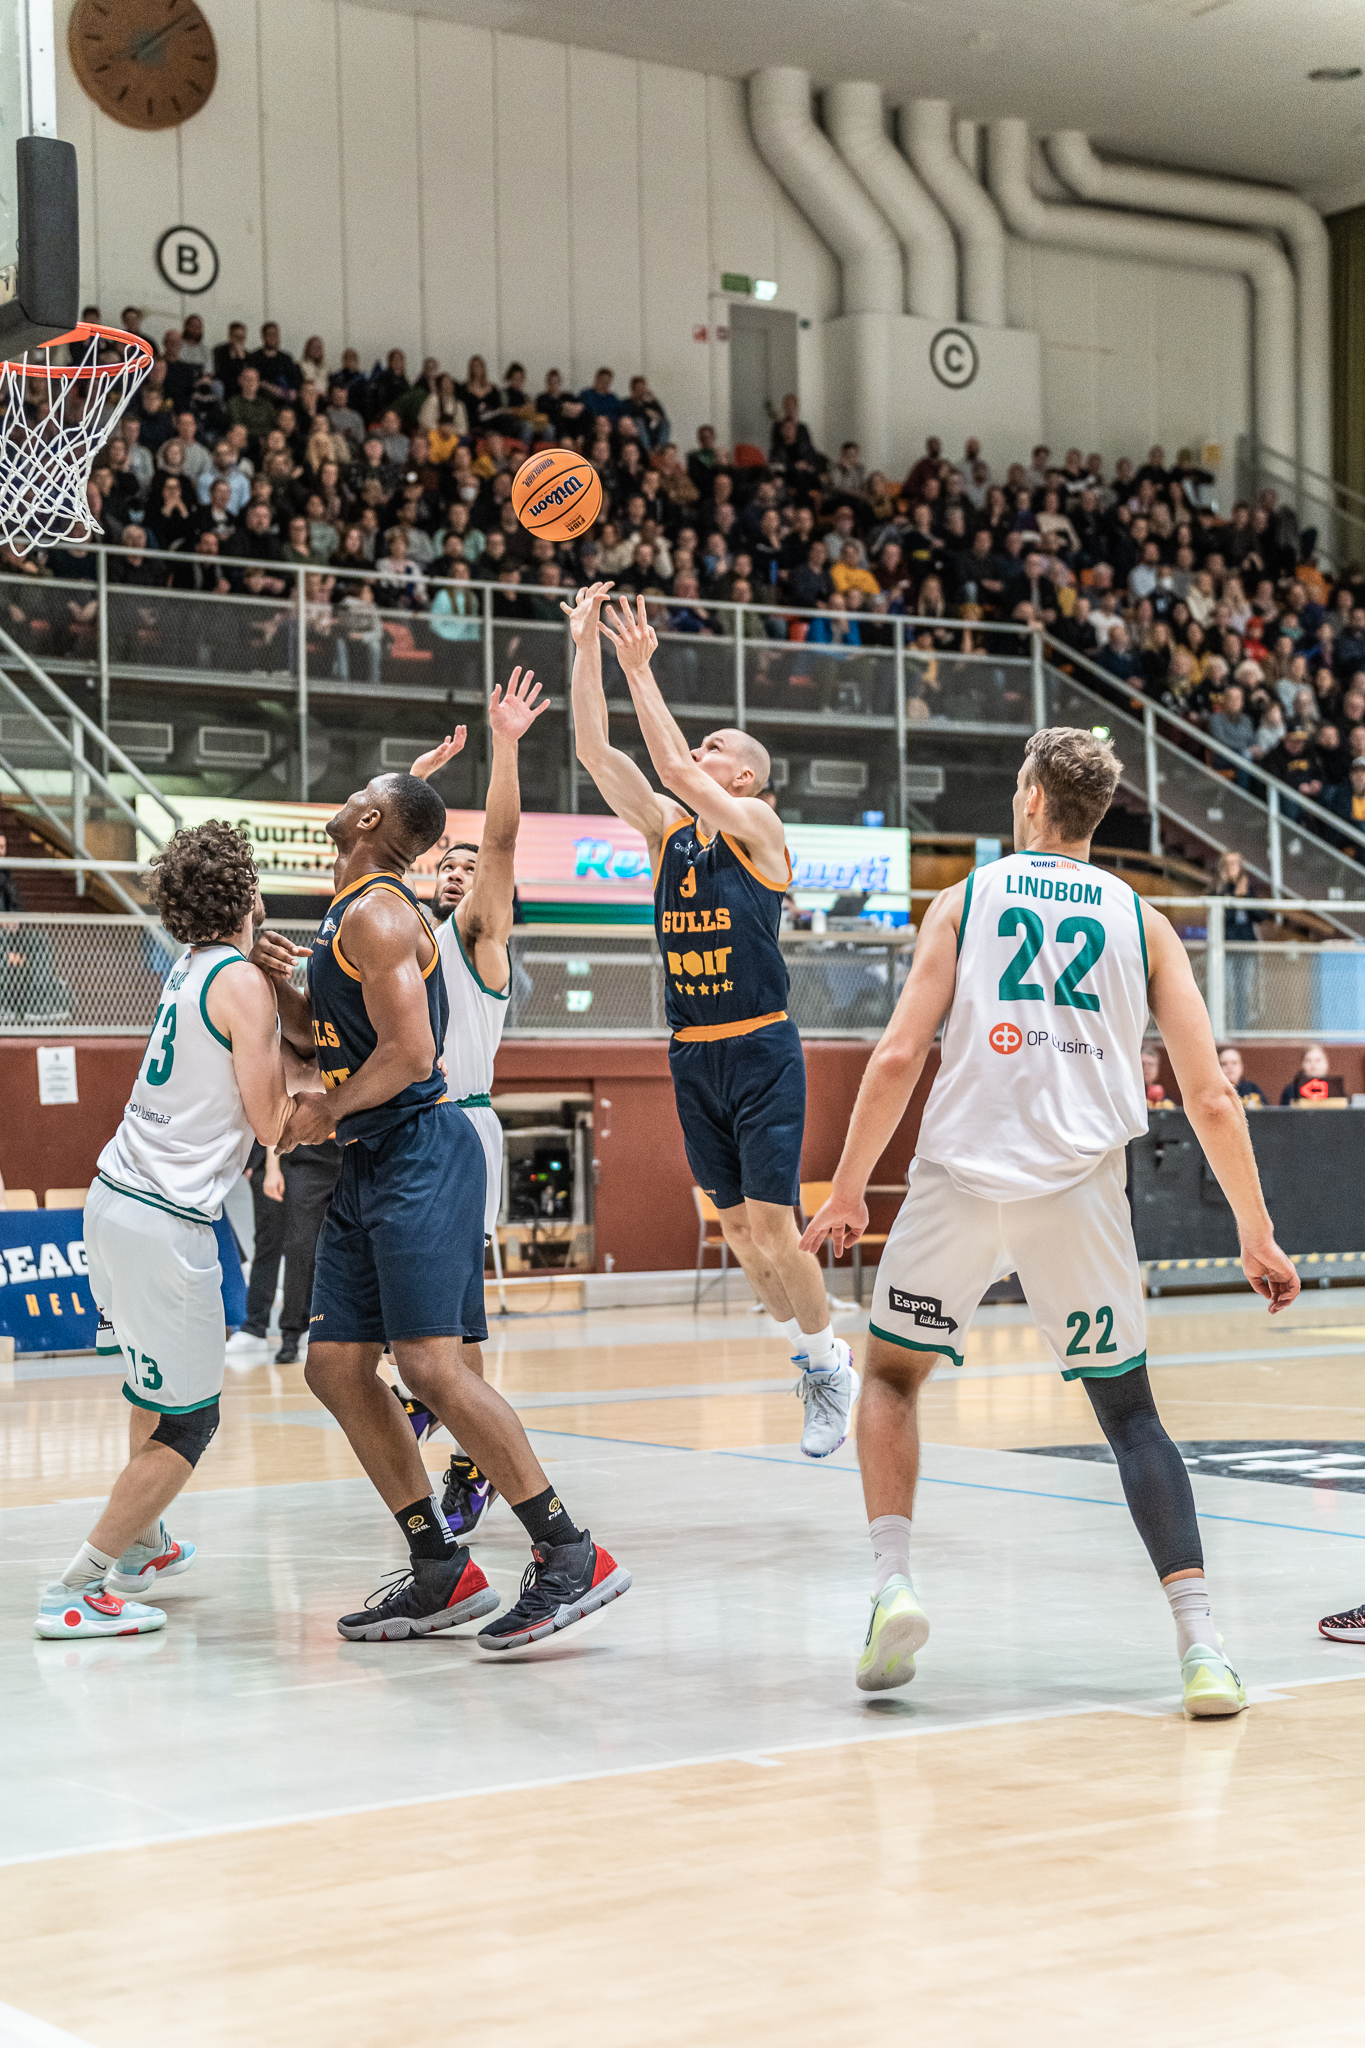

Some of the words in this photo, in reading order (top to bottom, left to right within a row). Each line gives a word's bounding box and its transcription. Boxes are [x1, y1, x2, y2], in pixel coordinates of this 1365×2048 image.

[178, 244, 198, 275] B
[944, 345, 964, 373] C
[529, 475, 584, 516] Wilson
[568, 517, 586, 533] FIBA
[237, 818, 337, 854] Suurta
[1006, 875, 1102, 906] LINDBOM
[662, 907, 732, 933] GULLS
[998, 906, 1106, 1012] 22
[1027, 1030, 1049, 1046] OP
[0, 1240, 89, 1287] EAG
[25, 1292, 86, 1316] HEL
[893, 1293, 936, 1313] Espoo
[1066, 1305, 1118, 1356] 22
[127, 1345, 163, 1390] 13
